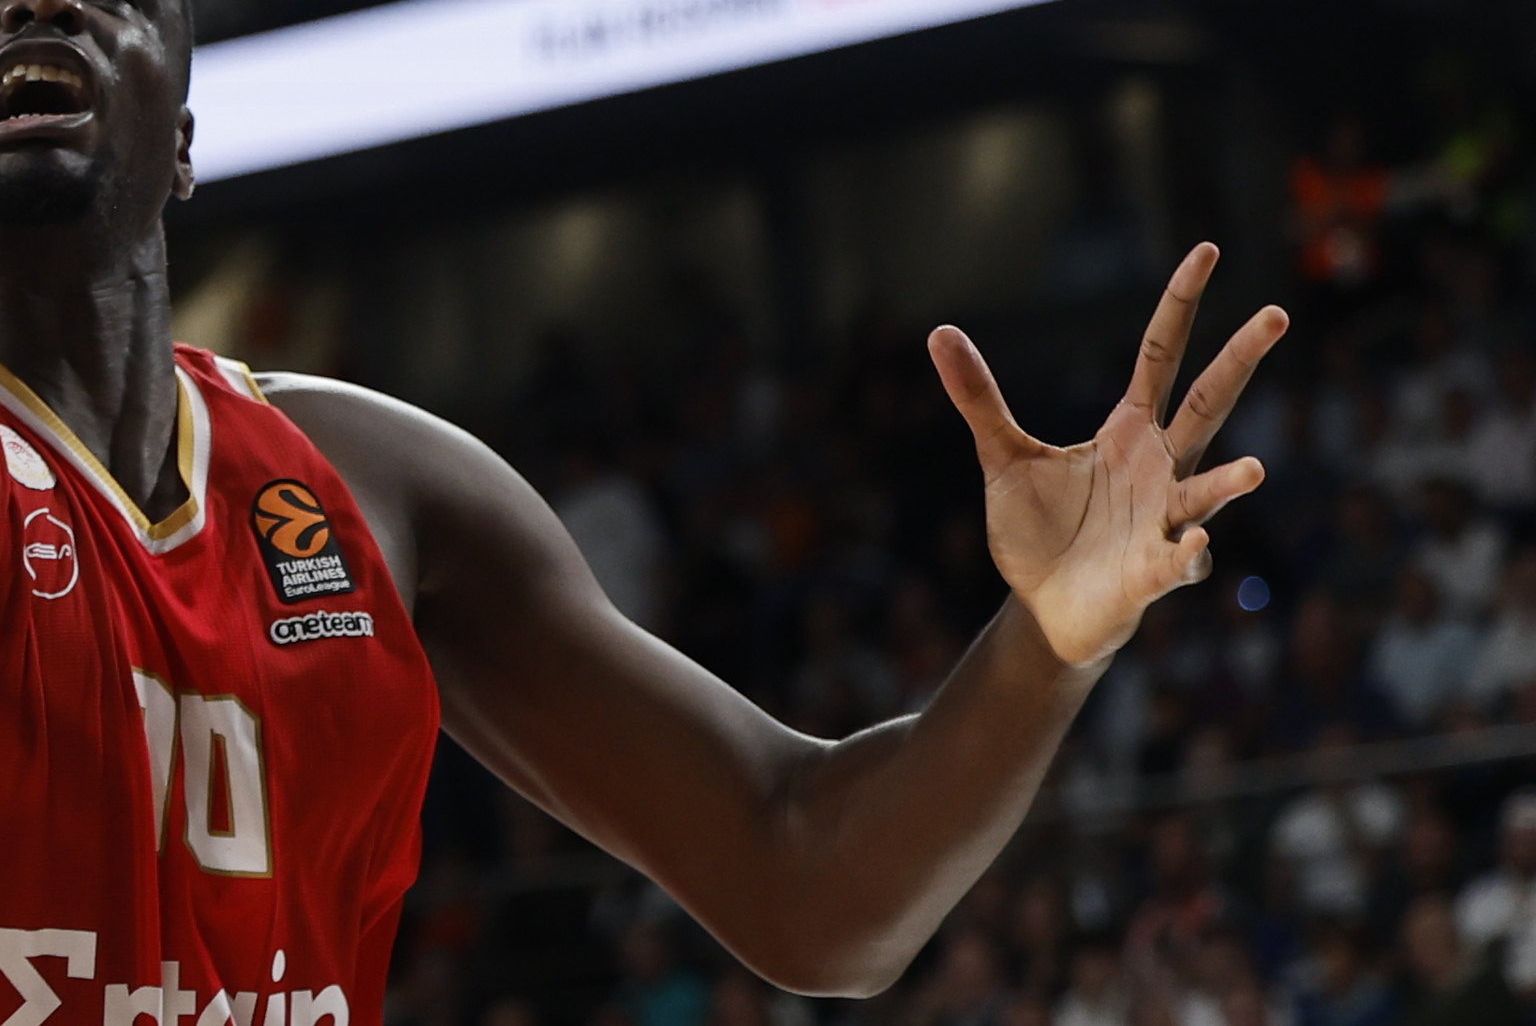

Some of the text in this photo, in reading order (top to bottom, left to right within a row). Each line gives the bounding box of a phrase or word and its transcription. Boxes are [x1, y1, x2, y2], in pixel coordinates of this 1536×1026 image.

[276, 555, 342, 575] TURKISH
[282, 567, 346, 588] AIRLINES
[284, 580, 351, 597] EuroLeague
